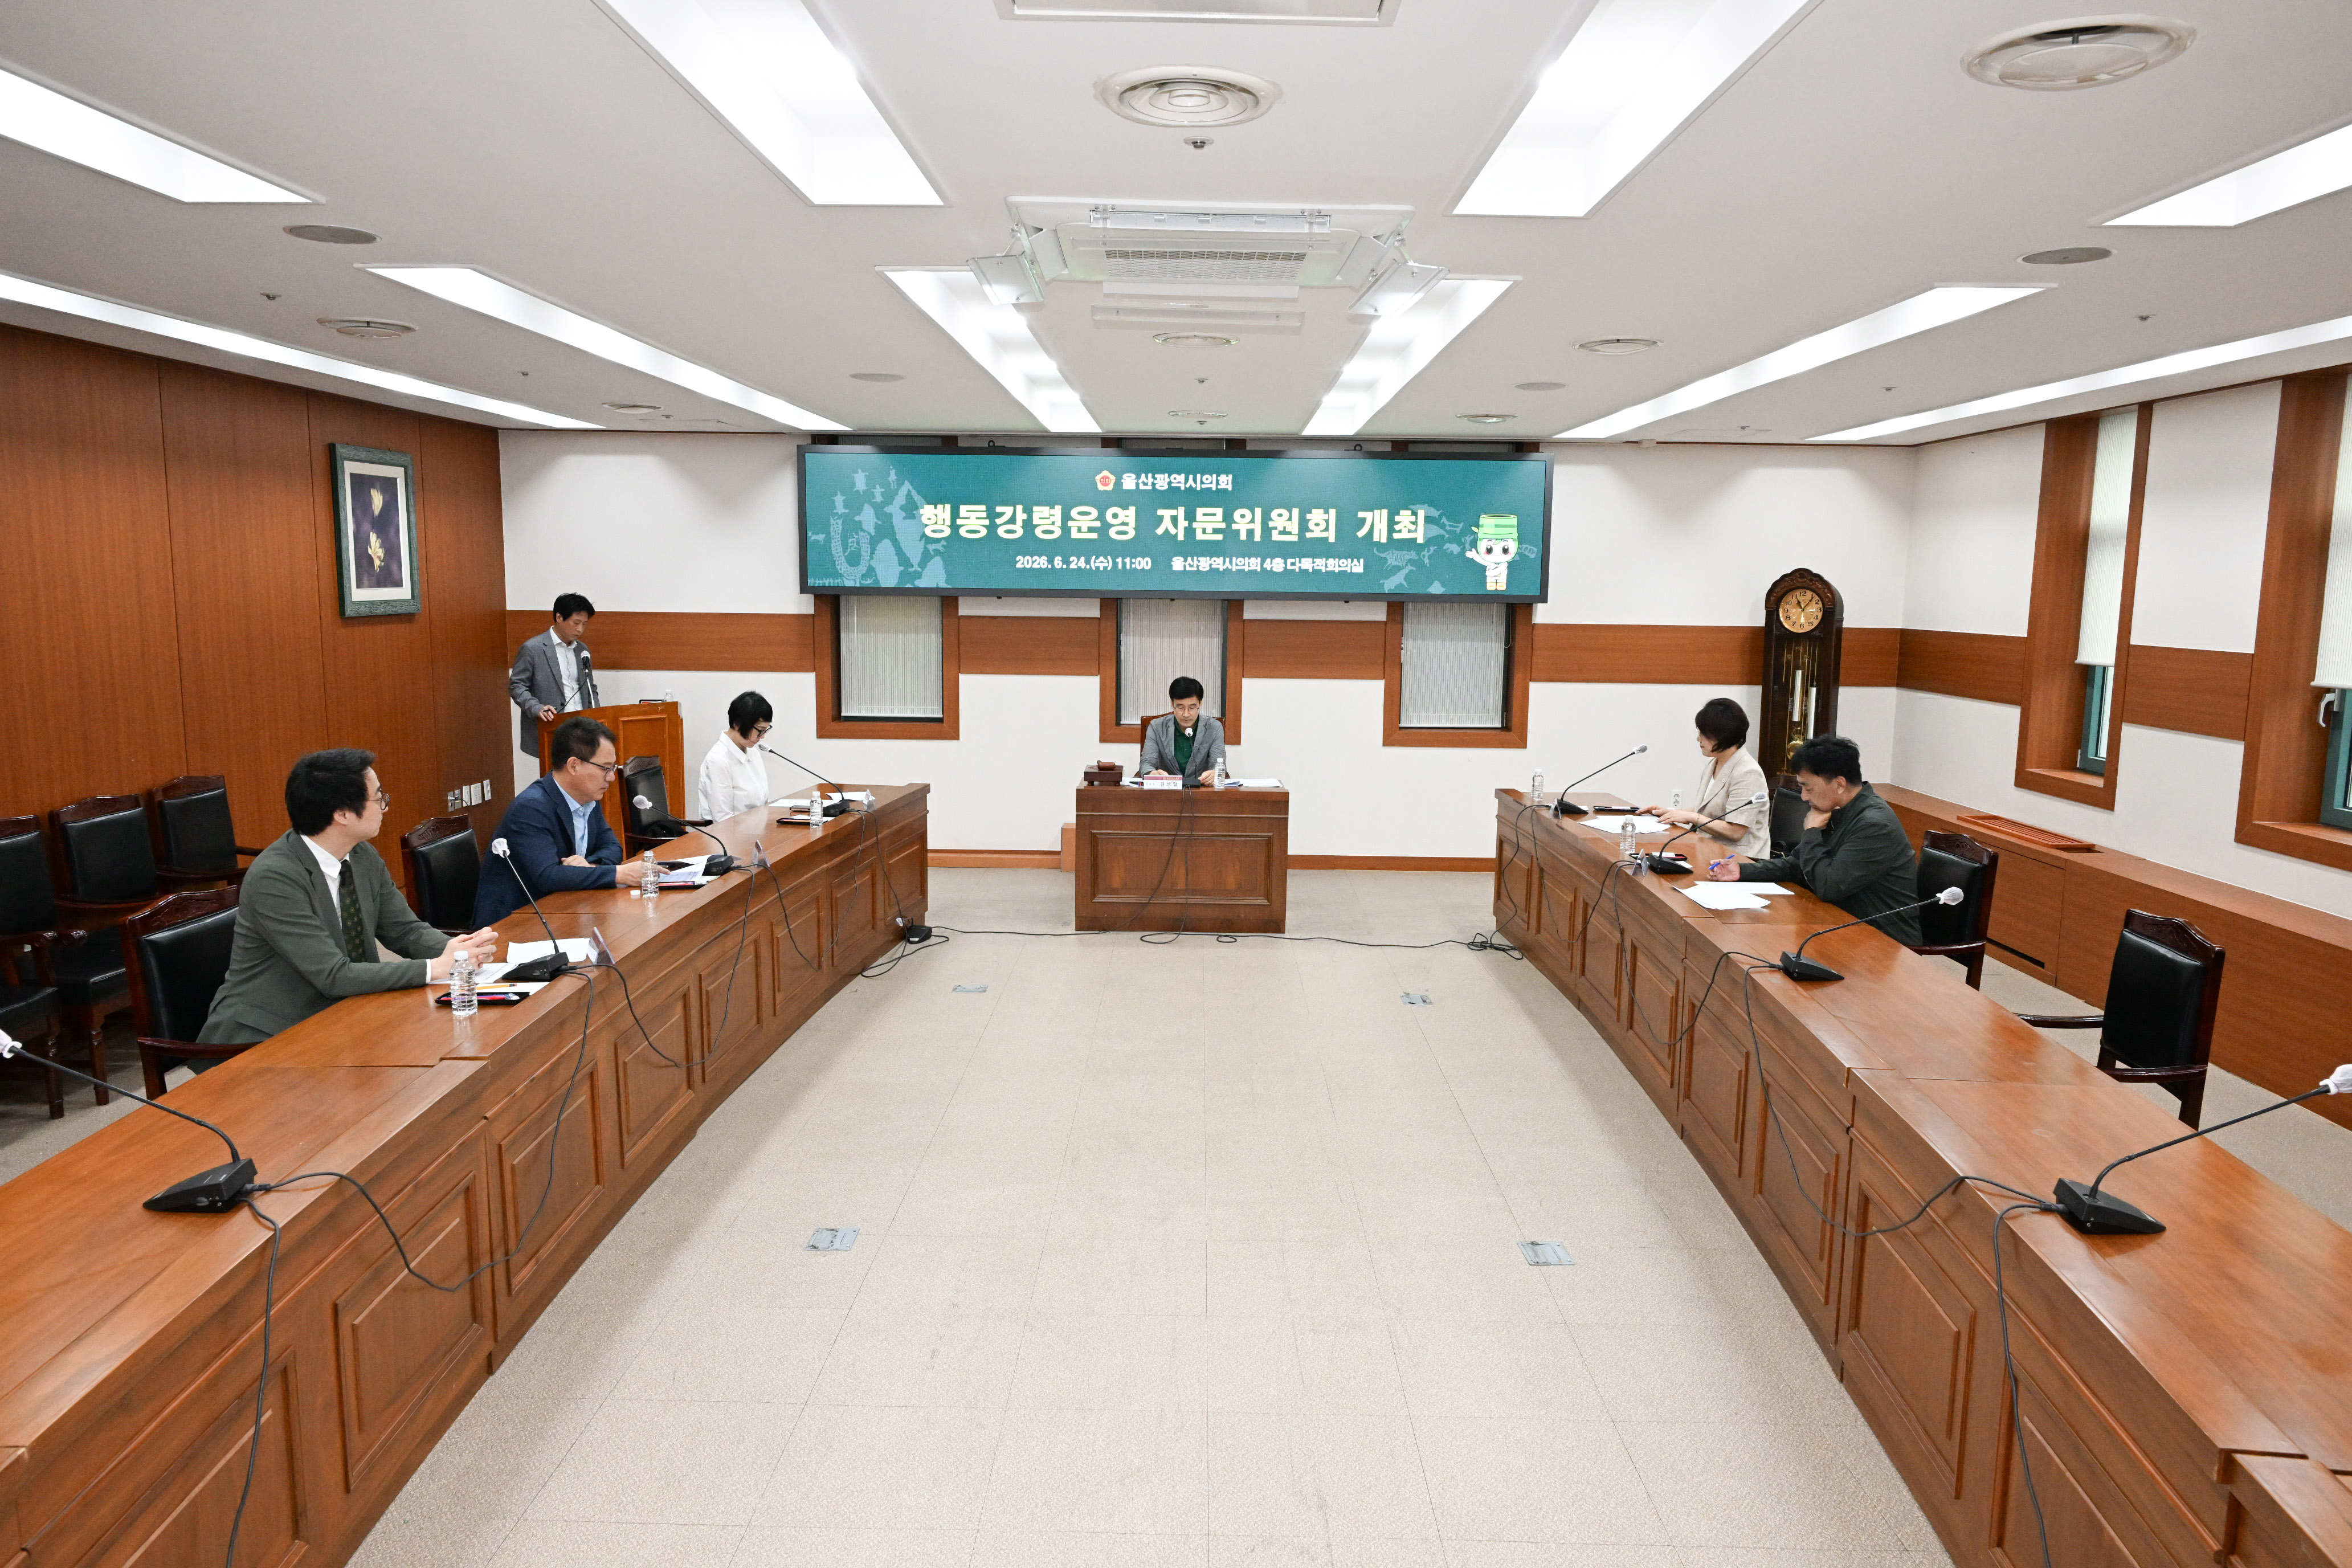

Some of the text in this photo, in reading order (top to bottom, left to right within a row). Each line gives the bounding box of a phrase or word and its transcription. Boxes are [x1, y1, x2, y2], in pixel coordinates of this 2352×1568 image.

[1121, 473, 1232, 491] 울산광역시의회
[920, 504, 1426, 544] 행동강령운영 자문위원회 개최
[1016, 556, 1152, 570] 2026. 6. 24.(수) 11:00
[1171, 556, 1364, 573] 울산광역시의회 4층 다목적회의실
